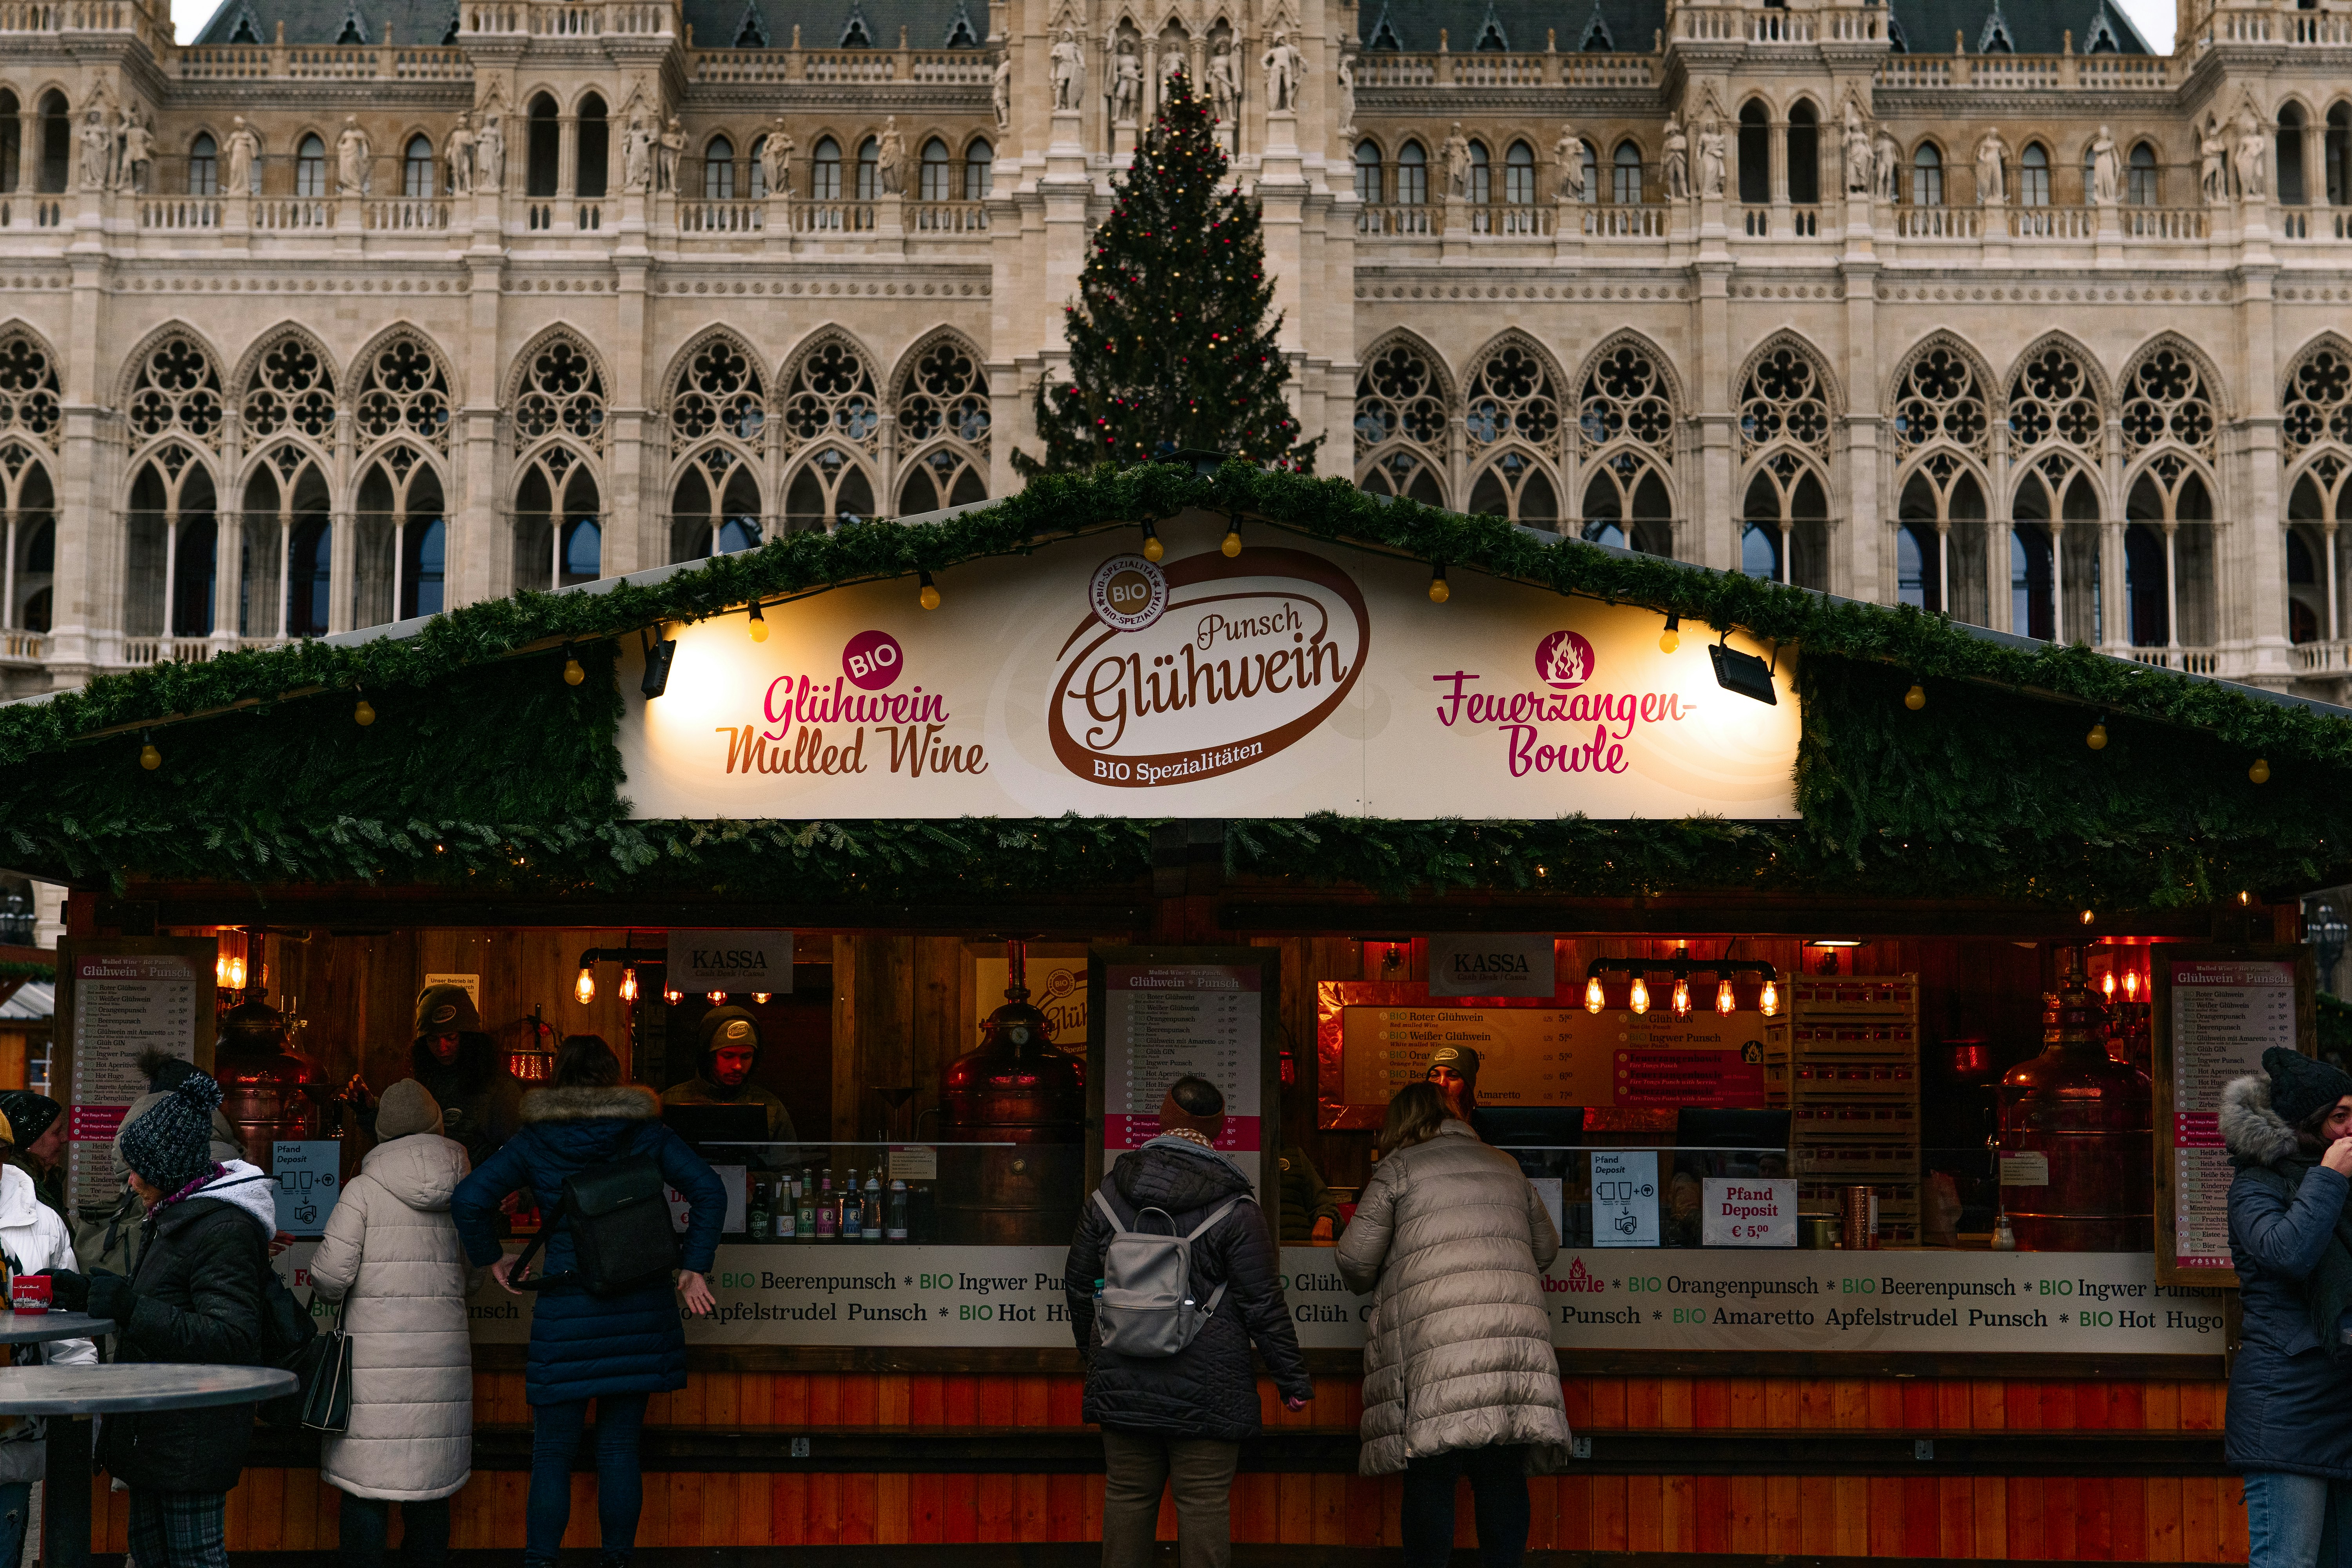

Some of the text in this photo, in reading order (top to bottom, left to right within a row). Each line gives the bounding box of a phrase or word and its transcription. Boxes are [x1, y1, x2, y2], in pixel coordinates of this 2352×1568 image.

[1096, 560, 1158, 597] BIO-SPEZIALITÄT
[1112, 583, 1147, 603] BIO
[1102, 590, 1162, 625] BIO-SPEZIALITÄT
[1197, 602, 1302, 651] Punsch
[848, 643, 897, 679] BIO
[1067, 632, 1347, 750] Glühwein
[764, 675, 949, 741] Glühwein
[1433, 670, 1697, 739] Feuerzangen-
[715, 724, 989, 778] Mulled Wine
[1499, 724, 1629, 777] Bowle
[1093, 741, 1263, 784] BIO Spezialitäten
[692, 950, 768, 969] KASSA
[1454, 954, 1530, 972] KASSA
[83, 965, 191, 978] Glühwein Punsch
[2178, 973, 2289, 984] Glühwein Punsch
[1130, 976, 1240, 988] Glühwein Punsch
[98, 1017, 141, 1025] Beerenpunsch
[1410, 1012, 1436, 1021] Roter
[1438, 1013, 1484, 1021] Glühwein
[1559, 1014, 1572, 1024] 5,80
[1629, 1013, 1694, 1024] BIO Glüh GIN
[1390, 1031, 1572, 1043] BIO Weißer Glühwein 5,80
[1629, 1032, 1721, 1044] BIO Ingwer Punsch
[1390, 1051, 1407, 1059] BIO
[1559, 1053, 1572, 1062] 5,50
[1559, 1072, 1573, 1081] 6,50
[118, 1083, 146, 1092] Apfelstrudel
[1477, 1090, 1572, 1100] Amaretto 7,50
[277, 1145, 301, 1154] Pfand
[277, 1156, 307, 1164] Deposit
[1595, 1167, 1625, 1175] Deposit
[1726, 1187, 1773, 1200] Pfand
[1722, 1203, 1778, 1220] Deposit
[1731, 1225, 1769, 1240] € 5,00
[722, 1272, 896, 1294] BIO Beerenpunsch
[920, 1273, 953, 1290] BIO
[958, 1272, 1027, 1295] Ingwer
[1628, 1276, 1661, 1292] BIO
[1666, 1275, 1819, 1299] Orangenpunsch
[1842, 1276, 2016, 1301] BIO Beerenpunsch
[2039, 1279, 2073, 1296] BIO
[2078, 1279, 2147, 1303] Ingwer
[703, 1302, 927, 1325] Apfelstrudel Punsch
[960, 1303, 1072, 1322] BIO Hot Hu
[1295, 1304, 1348, 1323] Glüh
[1561, 1306, 1641, 1325] Punsch
[1673, 1307, 2048, 1331] BIO Amaretto Apfelstrudel Punsch
[2080, 1309, 2224, 1333] BIO Hot Hugo
